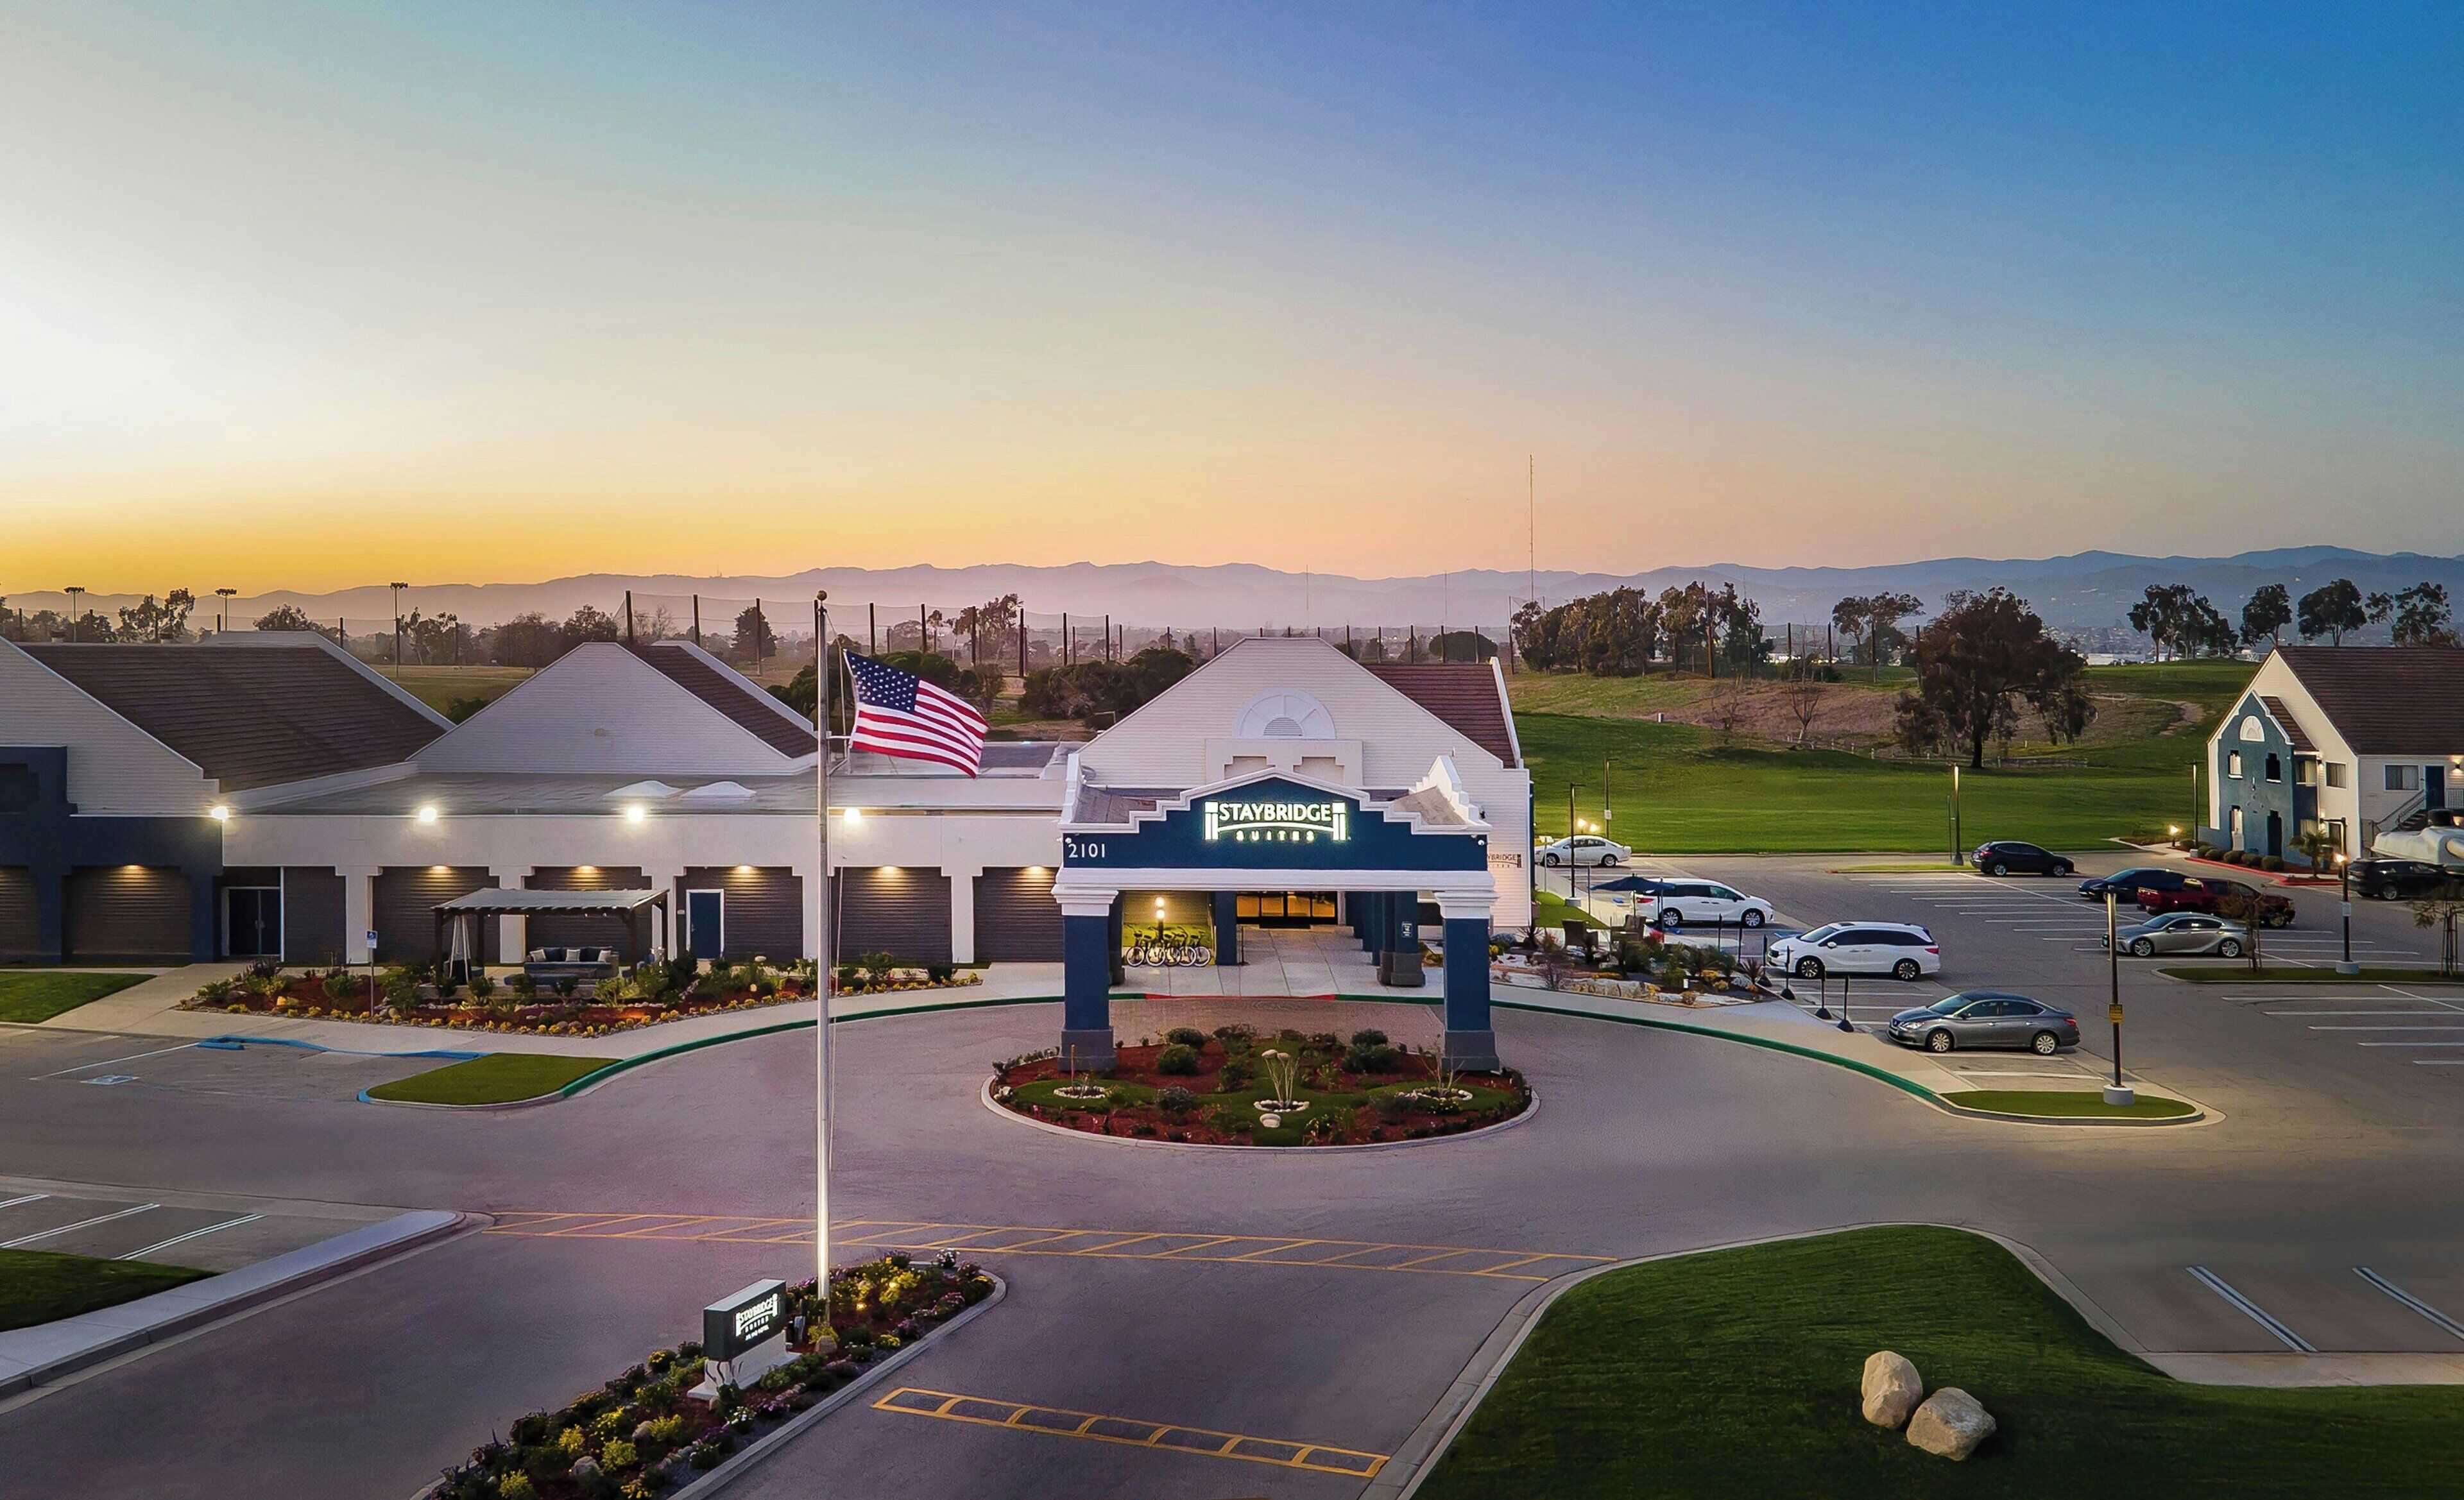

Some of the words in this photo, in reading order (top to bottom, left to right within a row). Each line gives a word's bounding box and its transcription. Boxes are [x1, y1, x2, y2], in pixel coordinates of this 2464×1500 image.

[1219, 803, 1331, 821] STAYBRIDGE
[1236, 830, 1314, 841] SUITES
[1068, 844, 1105, 858] 2101
